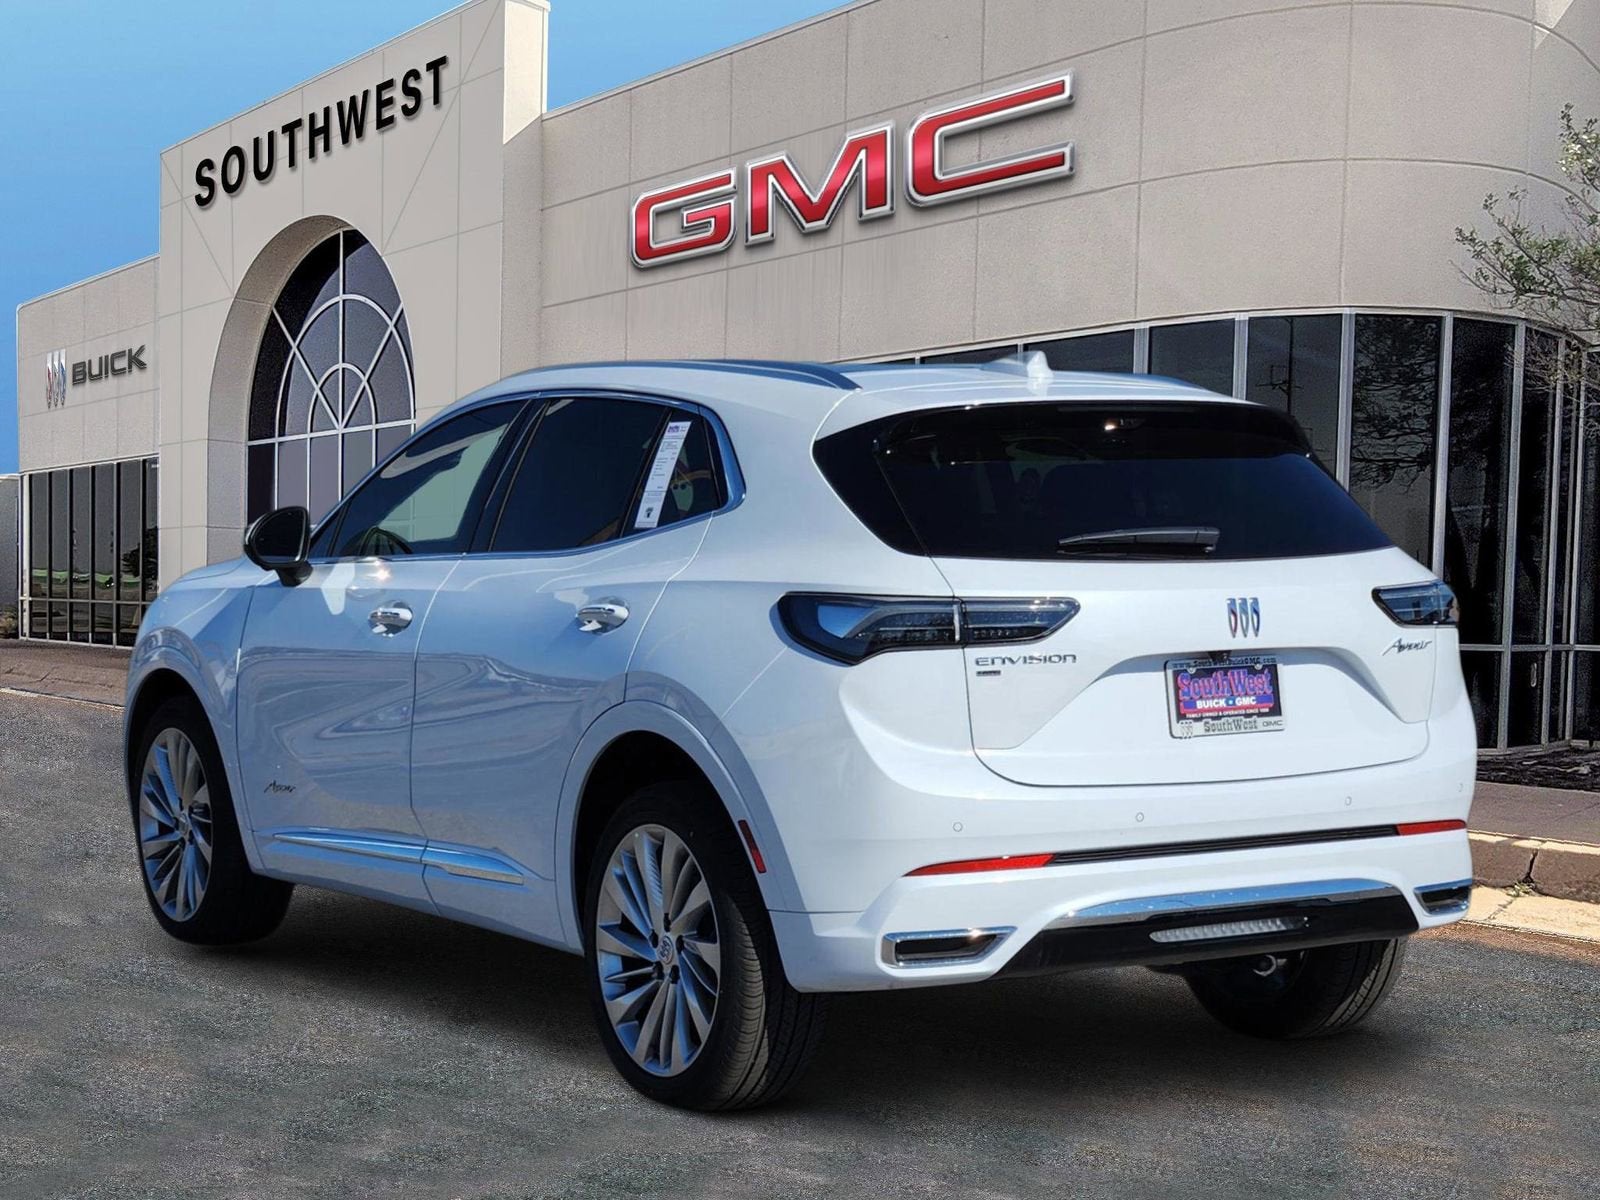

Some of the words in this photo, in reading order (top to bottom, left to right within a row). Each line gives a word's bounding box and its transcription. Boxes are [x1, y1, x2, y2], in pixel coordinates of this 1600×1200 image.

[194, 55, 448, 208] SOUTHWEST
[630, 67, 1076, 269] GMC
[71, 344, 148, 387] BUICK
[975, 654, 1077, 666] ENVISION
[1177, 668, 1273, 701] SouthWest
[1196, 699, 1226, 710] BUICK
[1235, 696, 1257, 707] GMC
[1203, 718, 1259, 733] SouthWest
[1262, 719, 1284, 728] GMC
